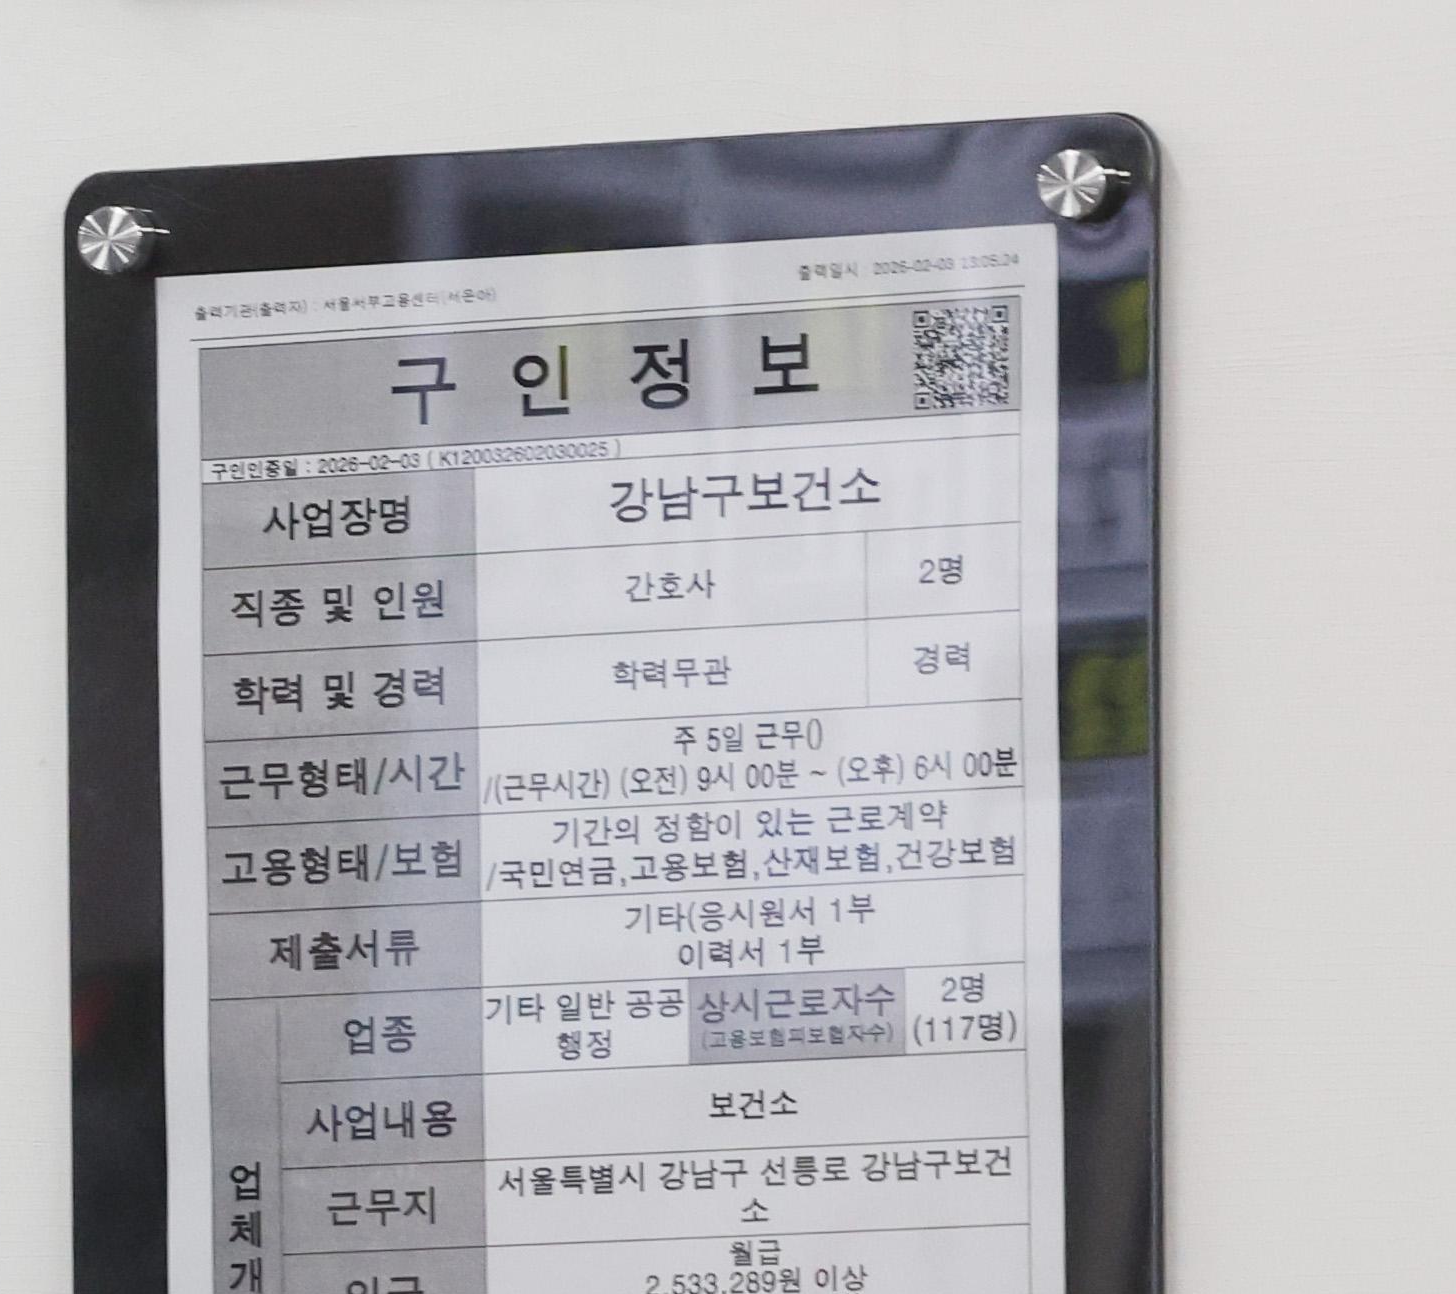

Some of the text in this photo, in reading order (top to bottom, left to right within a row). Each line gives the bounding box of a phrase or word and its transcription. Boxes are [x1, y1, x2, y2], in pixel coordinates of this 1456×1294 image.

[610, 467, 881, 524] 강남구보건소
[625, 568, 716, 603] 간호사
[486, 988, 685, 1025] 기타 일반 공공
[696, 983, 896, 1025] 상시근로자수
[556, 1029, 611, 1062] 행정
[913, 1010, 1017, 1047] (117명)
[709, 1089, 798, 1120] 보건소
[814, 1264, 869, 1292] 이상
